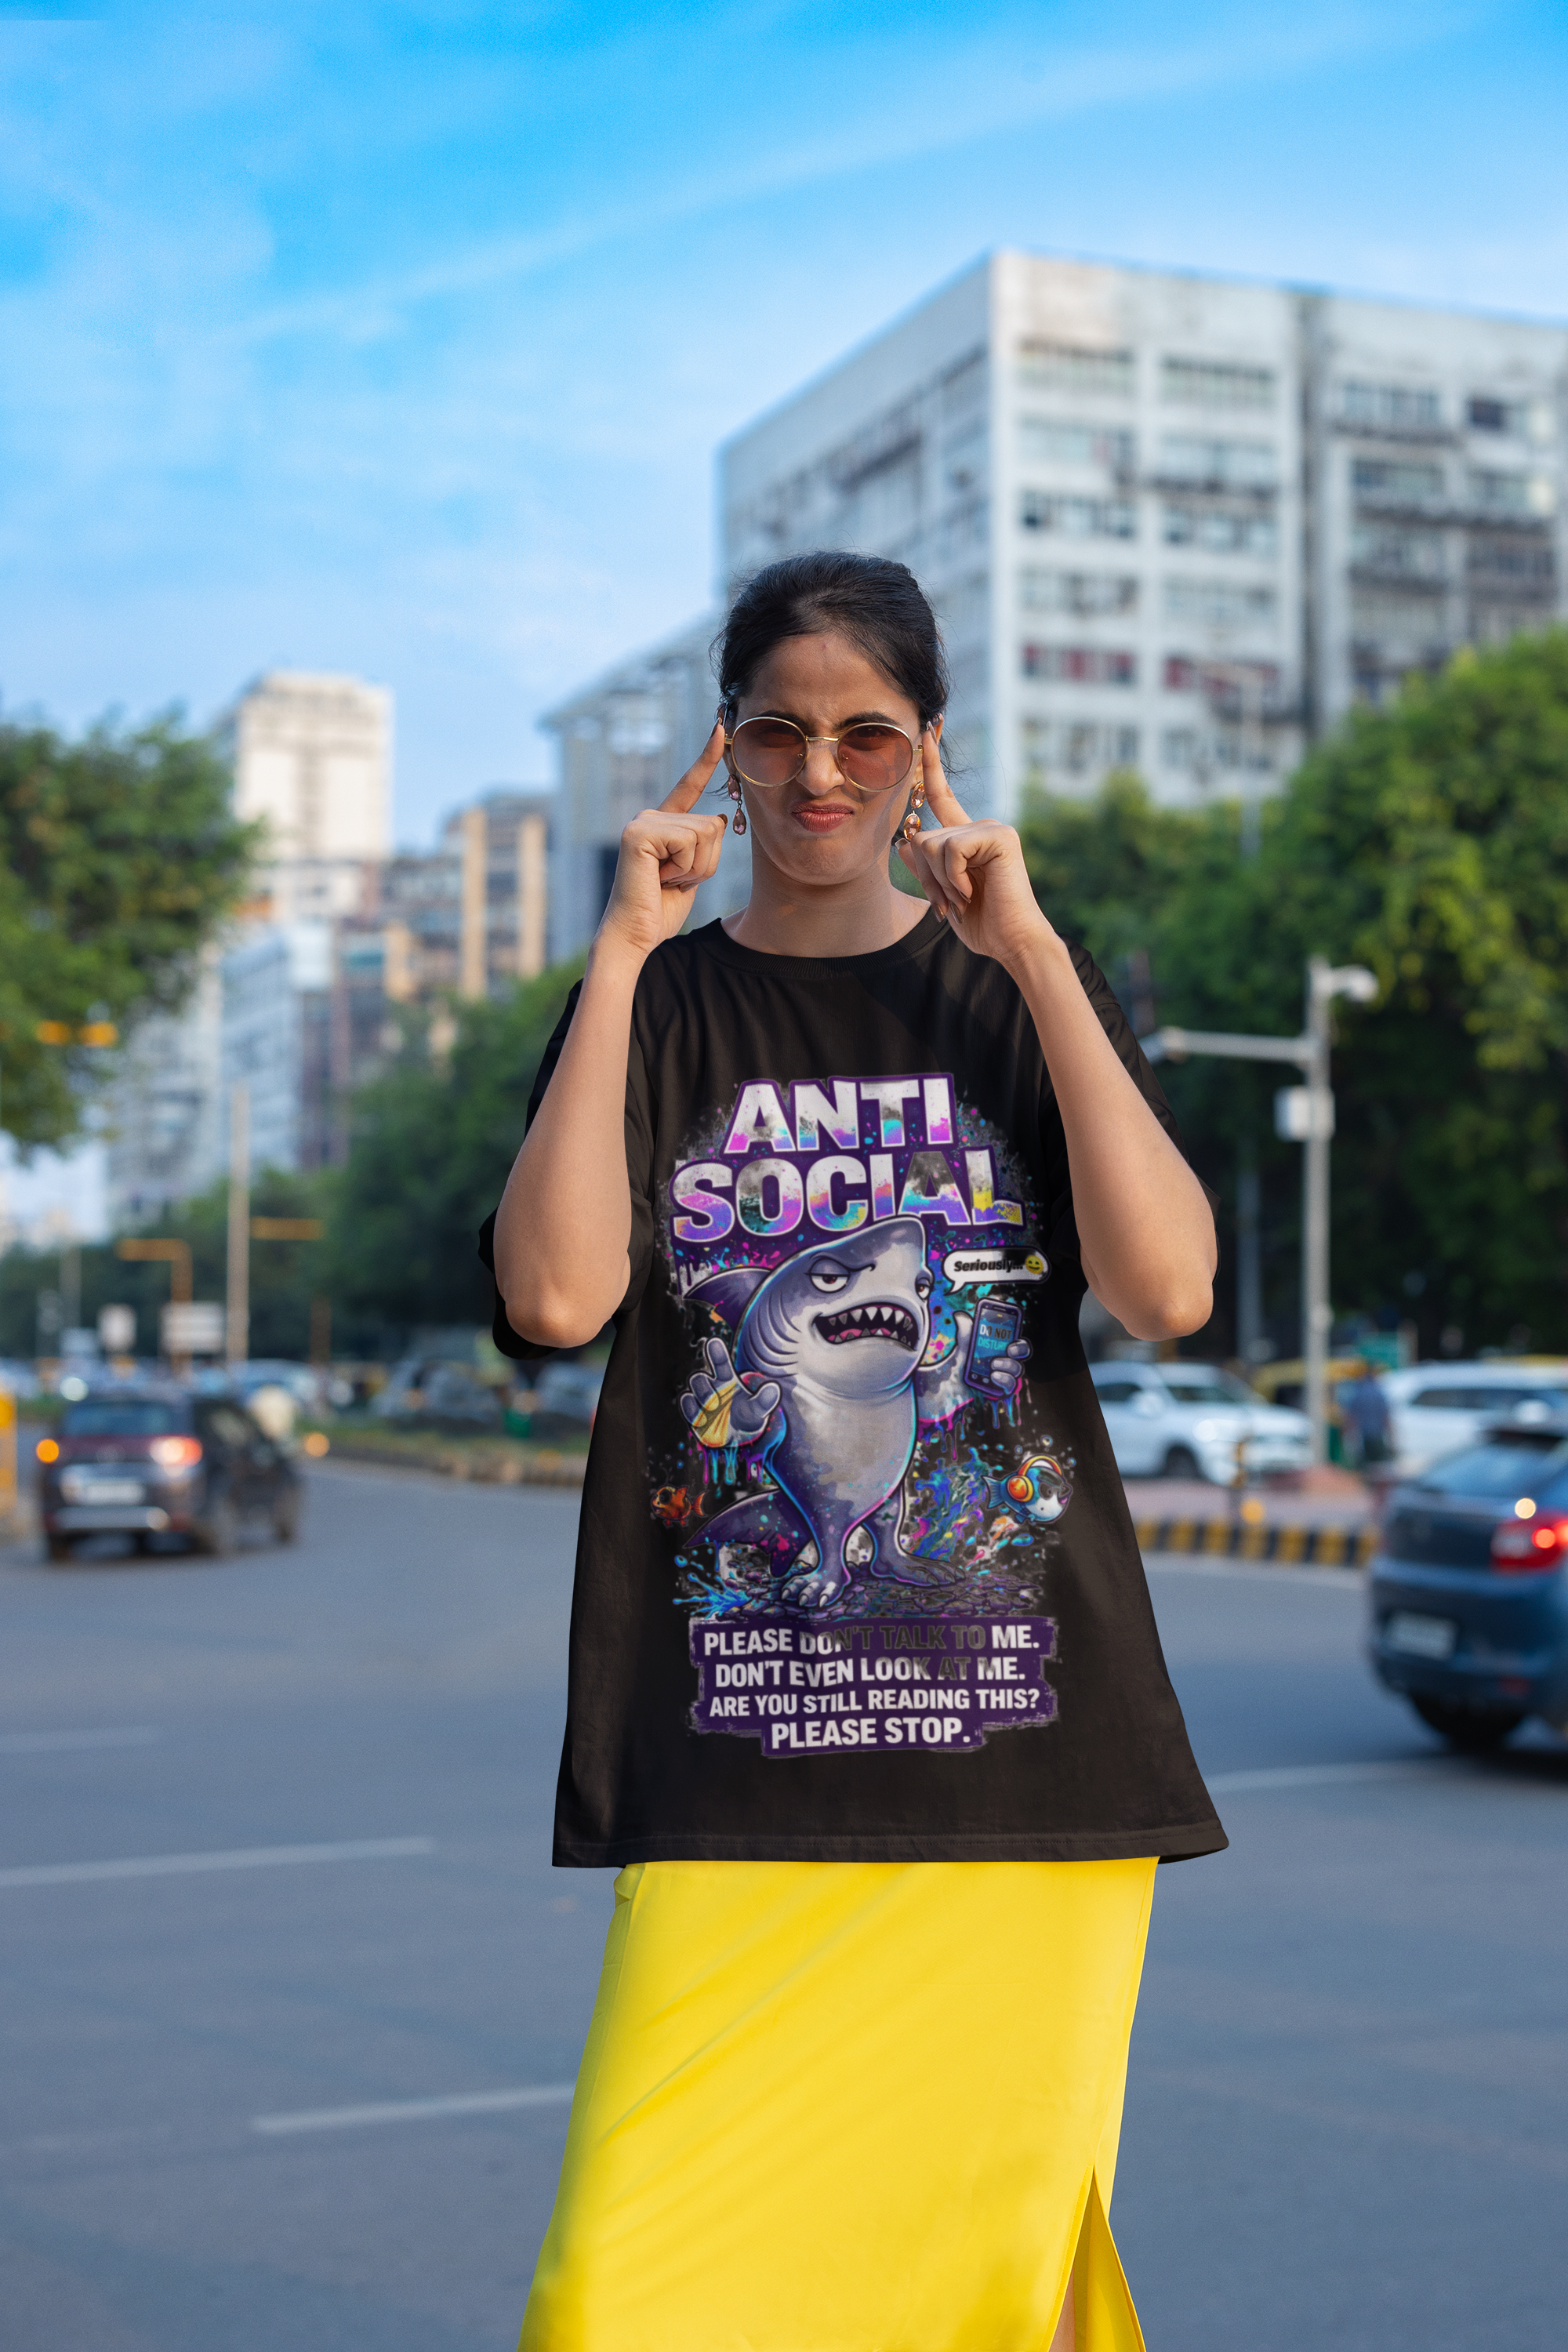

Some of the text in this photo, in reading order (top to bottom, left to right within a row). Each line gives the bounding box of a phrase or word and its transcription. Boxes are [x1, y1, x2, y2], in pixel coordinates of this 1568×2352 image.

[724, 1077, 953, 1154] ANTI
[673, 1149, 1024, 1243] SOCIAL
[980, 1324, 1012, 1340] DO NOT
[705, 1625, 1040, 1656] PLEASE DON'T TALK TO ME.
[716, 1657, 1025, 1687] DON'T EVEN LOOK AT ME.
[710, 1688, 1040, 1717] ARE YOU STILL READING THIS?
[771, 1717, 971, 1749] PLEASE STOP.
